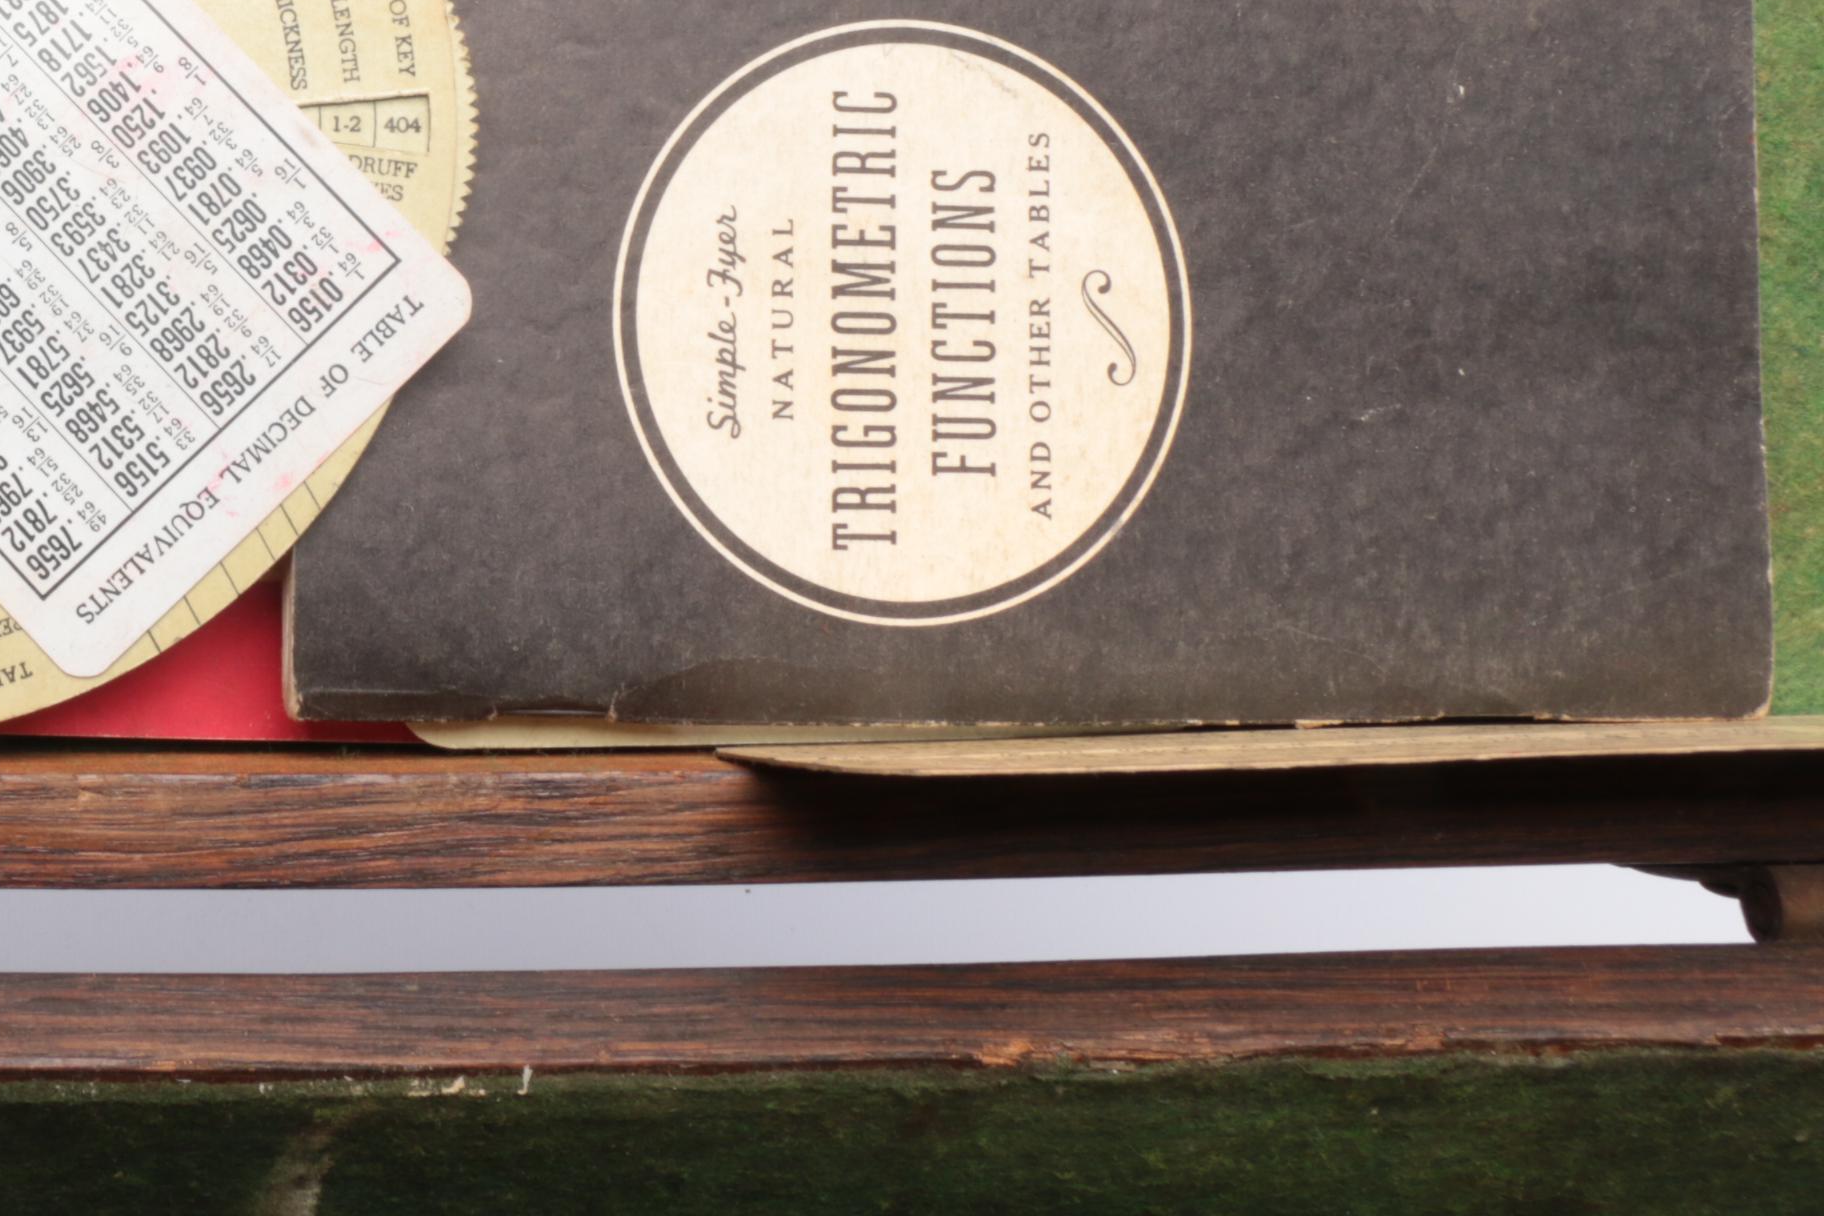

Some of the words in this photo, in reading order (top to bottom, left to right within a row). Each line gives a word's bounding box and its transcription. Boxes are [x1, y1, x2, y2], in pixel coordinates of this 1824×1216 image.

[395, 36, 416, 76] KEY
[383, 116, 421, 133] 404
[1029, 132, 1050, 278] TABLES
[287, 279, 345, 333] .0156
[351, 295, 424, 362] TABLE
[772, 218, 794, 420] NATURAL
[831, 90, 898, 551] TRIGONOMETRIC
[931, 169, 997, 477] FUNCTIONS
[199, 357, 256, 417] .2656
[317, 363, 350, 399] OF
[1029, 296, 1051, 423] OTHER
[120, 437, 171, 499] .5156
[218, 402, 316, 487] DECIMAL
[1029, 442, 1052, 520] AND
[1, 492, 57, 553] .7812
[25, 518, 82, 581] .7656
[75, 492, 221, 625] EQUIVALENTS
